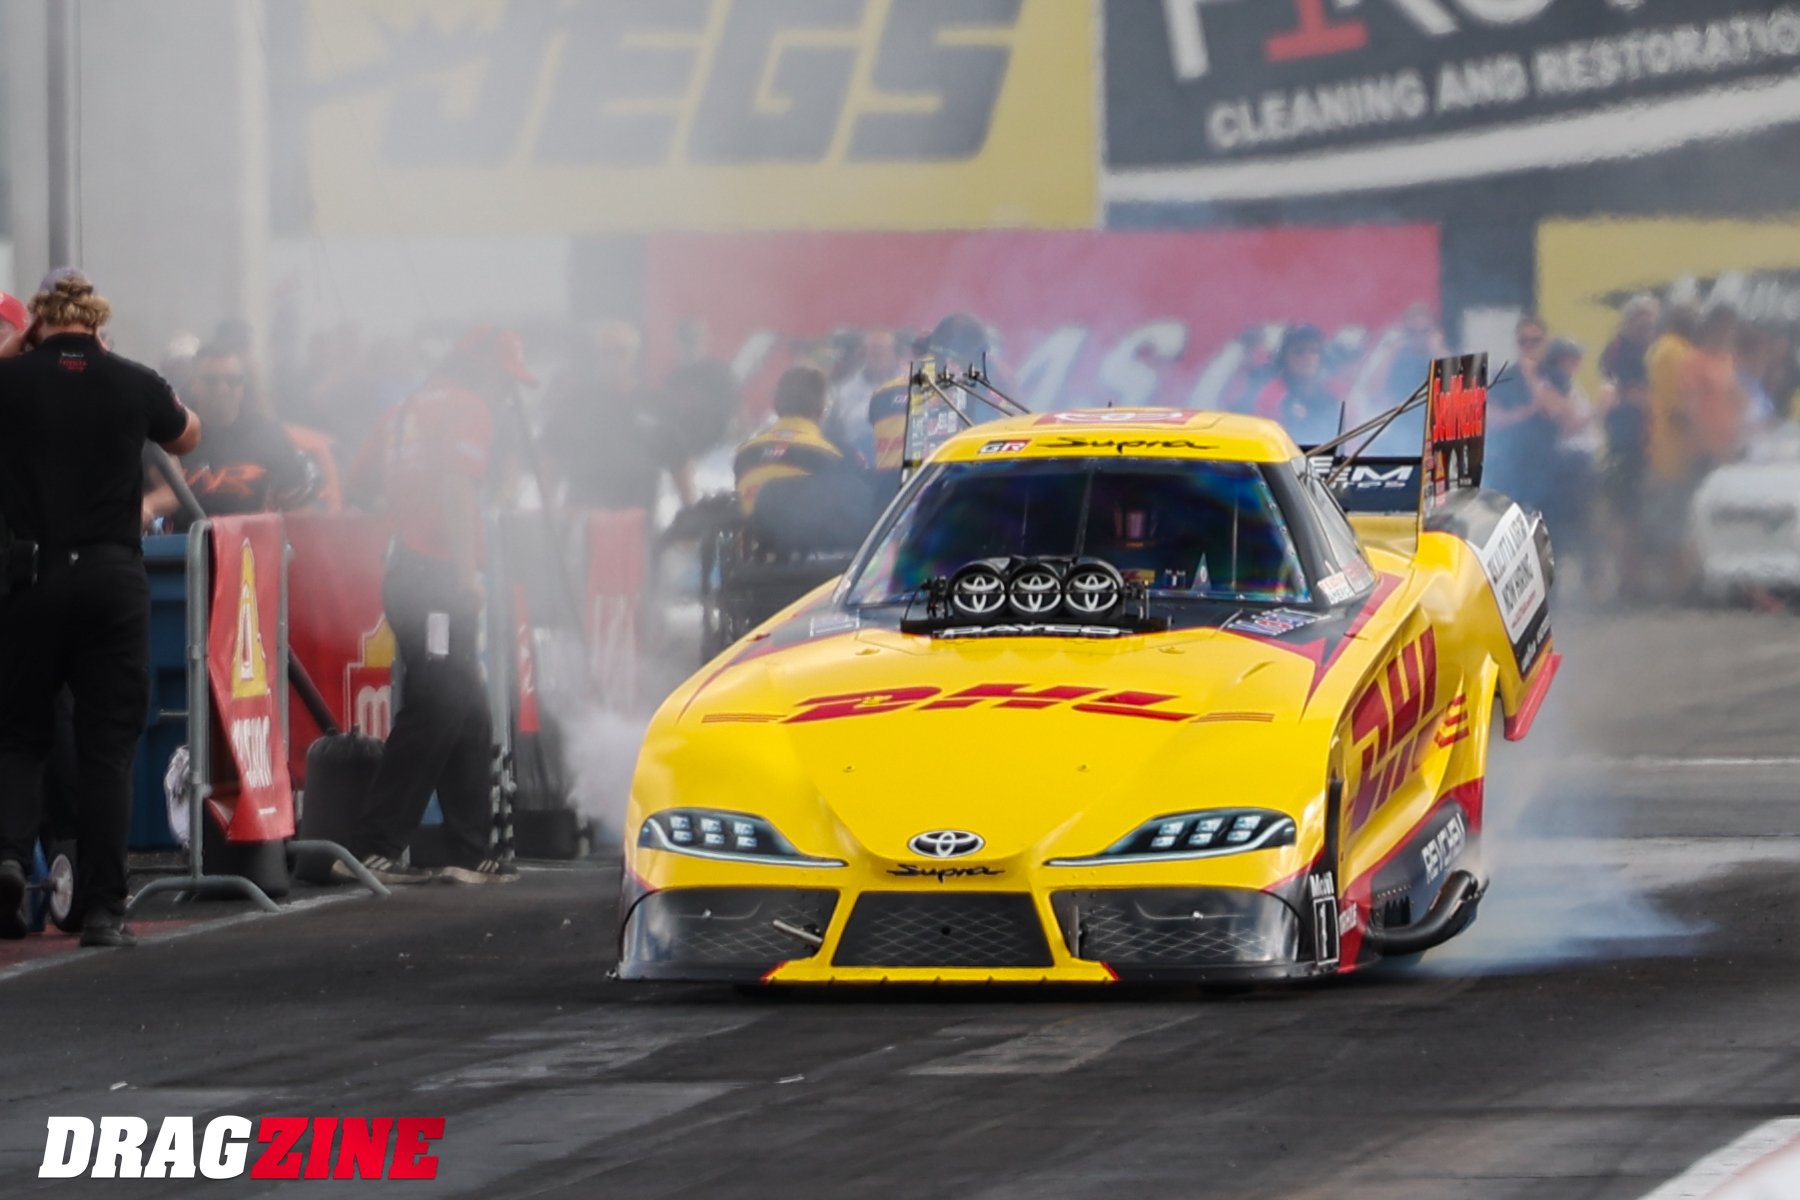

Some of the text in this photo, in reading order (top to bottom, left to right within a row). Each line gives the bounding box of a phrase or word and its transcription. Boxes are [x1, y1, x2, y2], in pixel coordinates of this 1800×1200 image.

[1207, 70, 1427, 150] CLEANING
[1436, 52, 1530, 110] AND
[978, 436, 1220, 455] GR Supra
[780, 682, 1200, 724] DHL
[1350, 624, 1448, 837] DHL
[886, 863, 1006, 884] Supra
